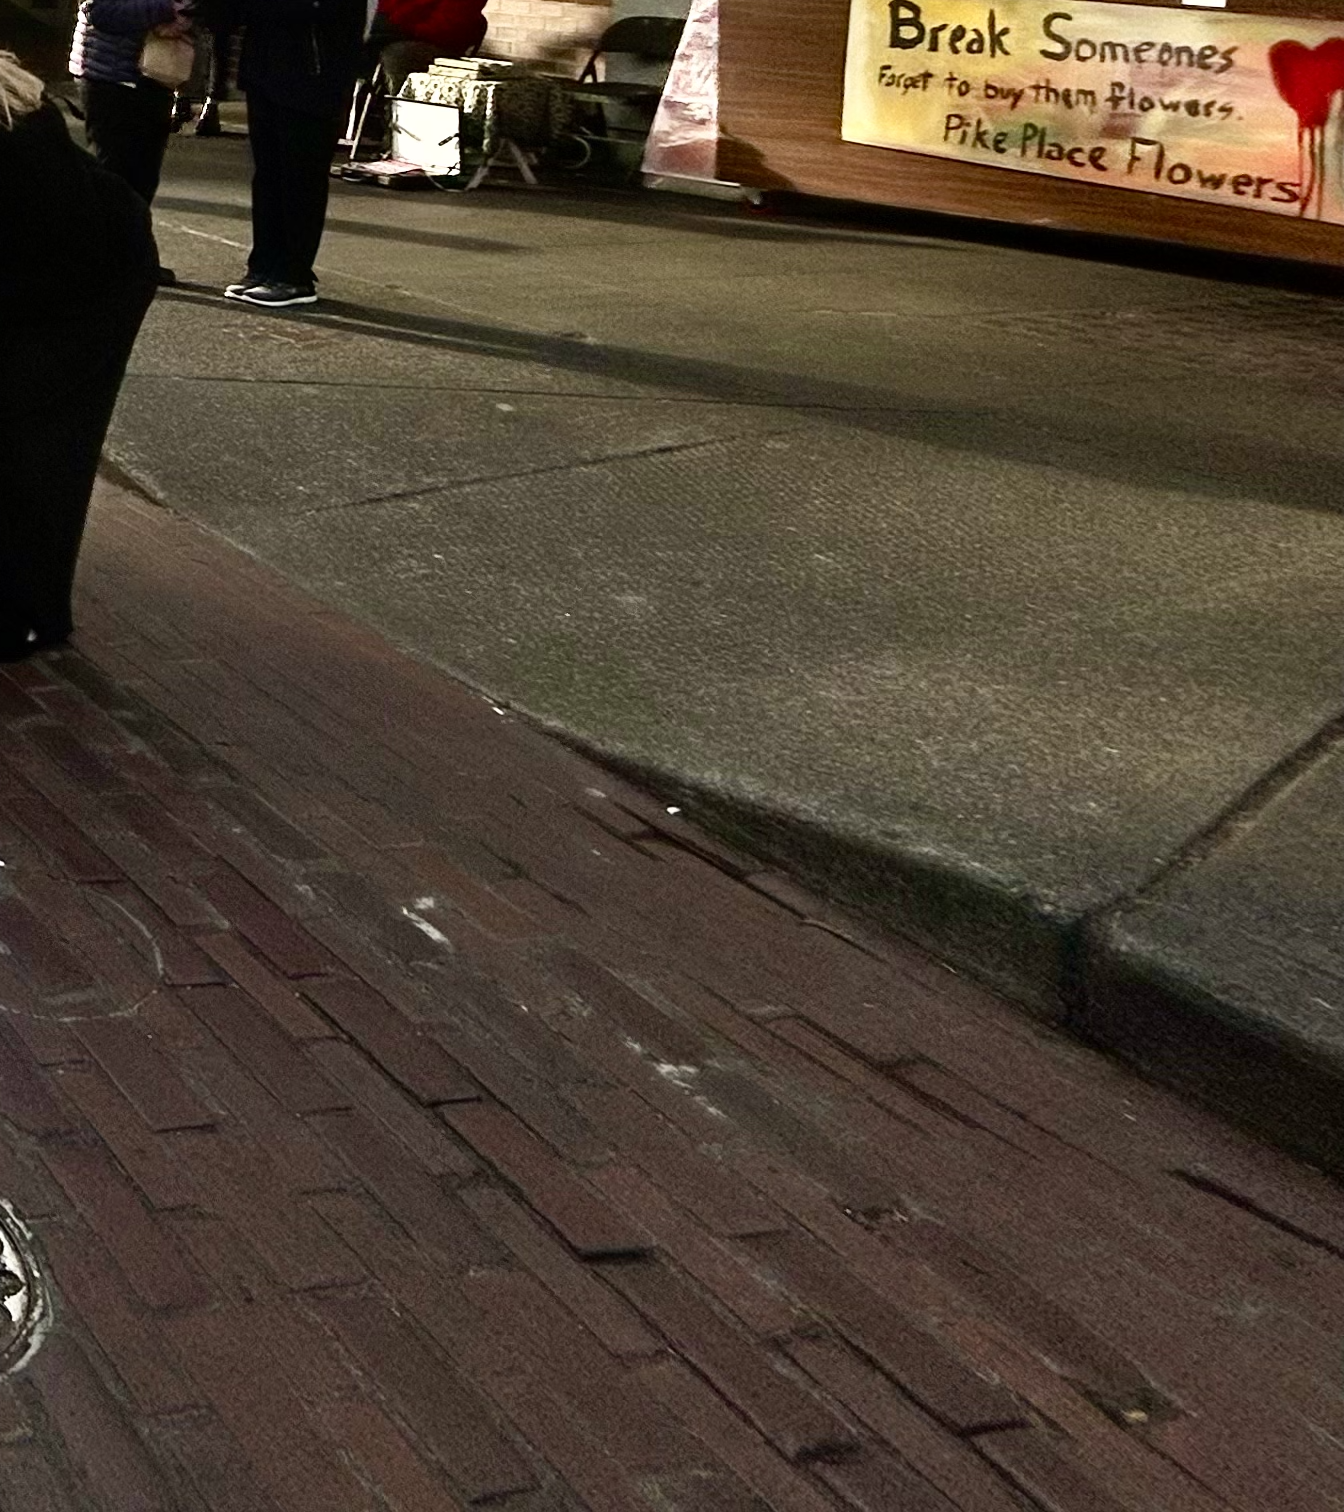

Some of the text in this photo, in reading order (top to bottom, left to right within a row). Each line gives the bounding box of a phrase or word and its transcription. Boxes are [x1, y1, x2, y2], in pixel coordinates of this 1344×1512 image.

[1039, 11, 1239, 75] Someones
[877, 65, 934, 94] Forget
[945, 71, 971, 98] to
[983, 80, 1026, 111] buy
[1032, 80, 1098, 113] them
[942, 112, 1303, 206] Pike Place Flowers
